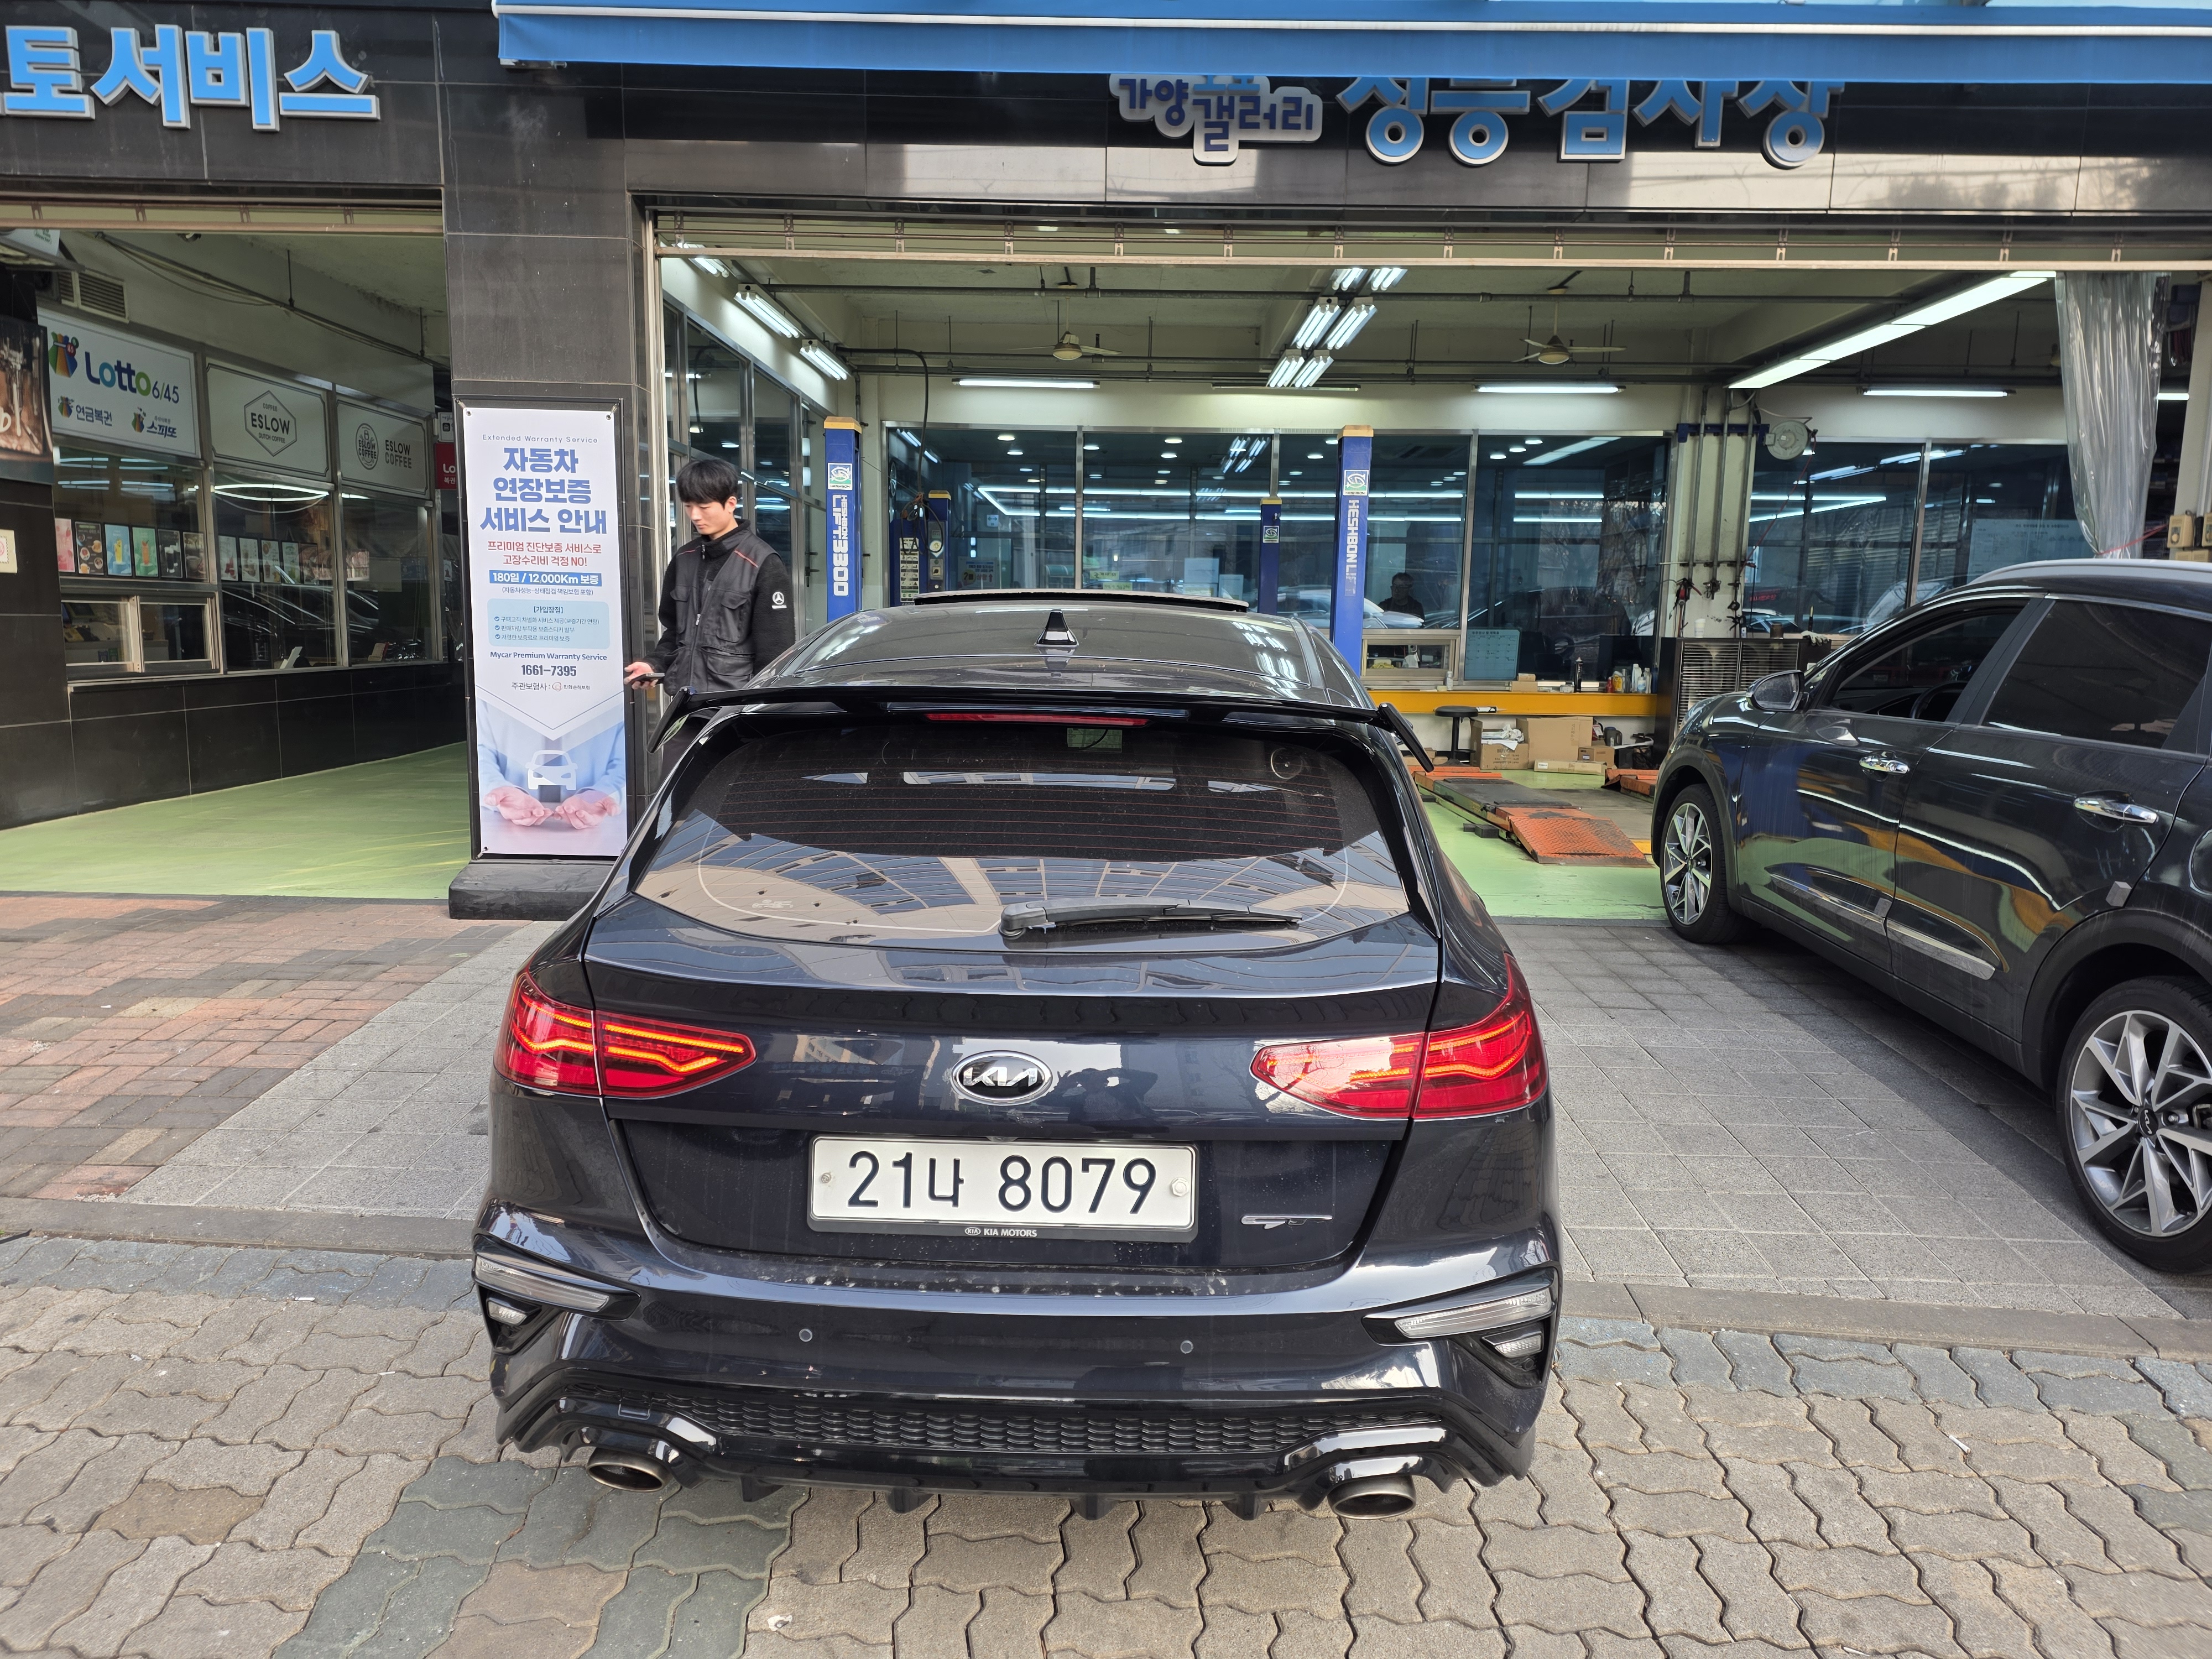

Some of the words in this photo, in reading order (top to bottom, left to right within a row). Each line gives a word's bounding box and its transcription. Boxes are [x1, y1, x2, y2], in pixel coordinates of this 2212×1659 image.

[3, 24, 380, 131] 토서비스
[1119, 79, 1188, 126] 가양
[1193, 96, 1313, 152] 갤러리
[85, 351, 152, 397] Lotto
[76, 405, 112, 426] 연금복권
[251, 412, 290, 435] ESLOW
[147, 421, 178, 438] 스피또
[258, 432, 271, 441] DUTCH
[272, 435, 286, 444] COFFEE
[358, 447, 377, 460] COFFEE
[385, 440, 410, 456] ESLOW
[385, 452, 412, 469] COFFEE
[503, 447, 579, 473] 자동차
[493, 477, 592, 504] 연장보증
[479, 507, 551, 533] 서비스
[557, 509, 607, 534] 안내
[832, 494, 842, 540] LIFT
[1346, 499, 1360, 563] HESHBON
[488, 541, 524, 552] 프리미엄
[526, 542, 563, 553] 진단보증
[565, 543, 602, 554] 서비스로
[503, 555, 549, 566] 고장수리비
[551, 556, 569, 566] 걱정
[571, 557, 588, 566] NO!
[833, 540, 849, 596] 3300
[492, 572, 519, 583] 180일
[529, 573, 579, 585] 12,000Km
[581, 575, 599, 585] 보증
[1345, 564, 1357, 595] LI
[533, 606, 563, 614] [가입장점]
[490, 651, 512, 660] Mycar
[546, 653, 581, 661] Warranty
[521, 665, 577, 677] 1661-7395
[511, 682, 547, 691] 주관보험사
[847, 1150, 964, 1208] 21나
[998, 1156, 1157, 1214] 8079
[1001, 1229, 1037, 1238] MOTORS
